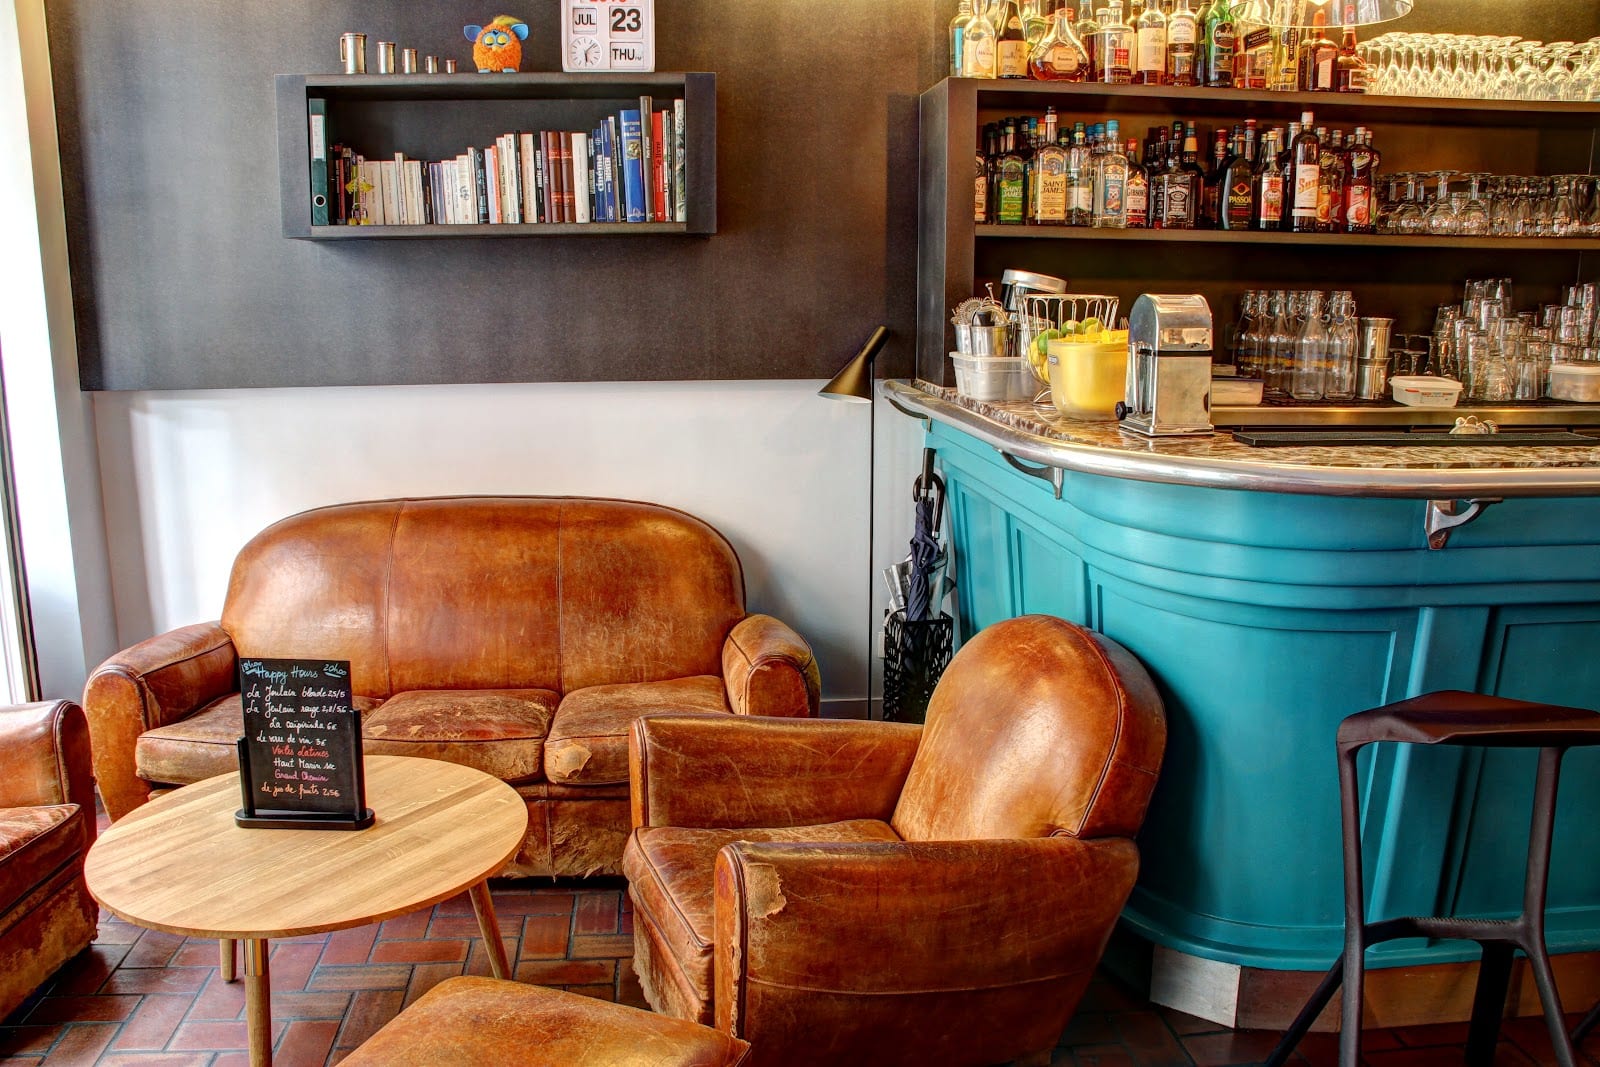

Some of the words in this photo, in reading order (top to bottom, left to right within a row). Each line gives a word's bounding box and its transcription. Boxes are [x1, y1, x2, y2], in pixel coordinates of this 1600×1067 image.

[575, 14, 596, 25] JUL
[612, 8, 641, 32] 23
[612, 48, 634, 60] THU
[596, 154, 604, 192] cinéma
[255, 665, 288, 685] Happy
[291, 665, 318, 678] Hours
[323, 663, 347, 675] 20h00
[247, 684, 260, 698] La
[246, 698, 259, 713] La
[301, 705, 320, 718] rouge
[270, 717, 281, 728] La
[257, 730, 267, 743] Le
[287, 733, 296, 743] de
[299, 736, 313, 744] vin
[297, 746, 329, 757] Latines
[273, 758, 294, 767] Haut
[275, 769, 299, 780] Grand
[302, 771, 328, 781] Chemin
[285, 784, 296, 793] de
[299, 784, 319, 799] fruits
